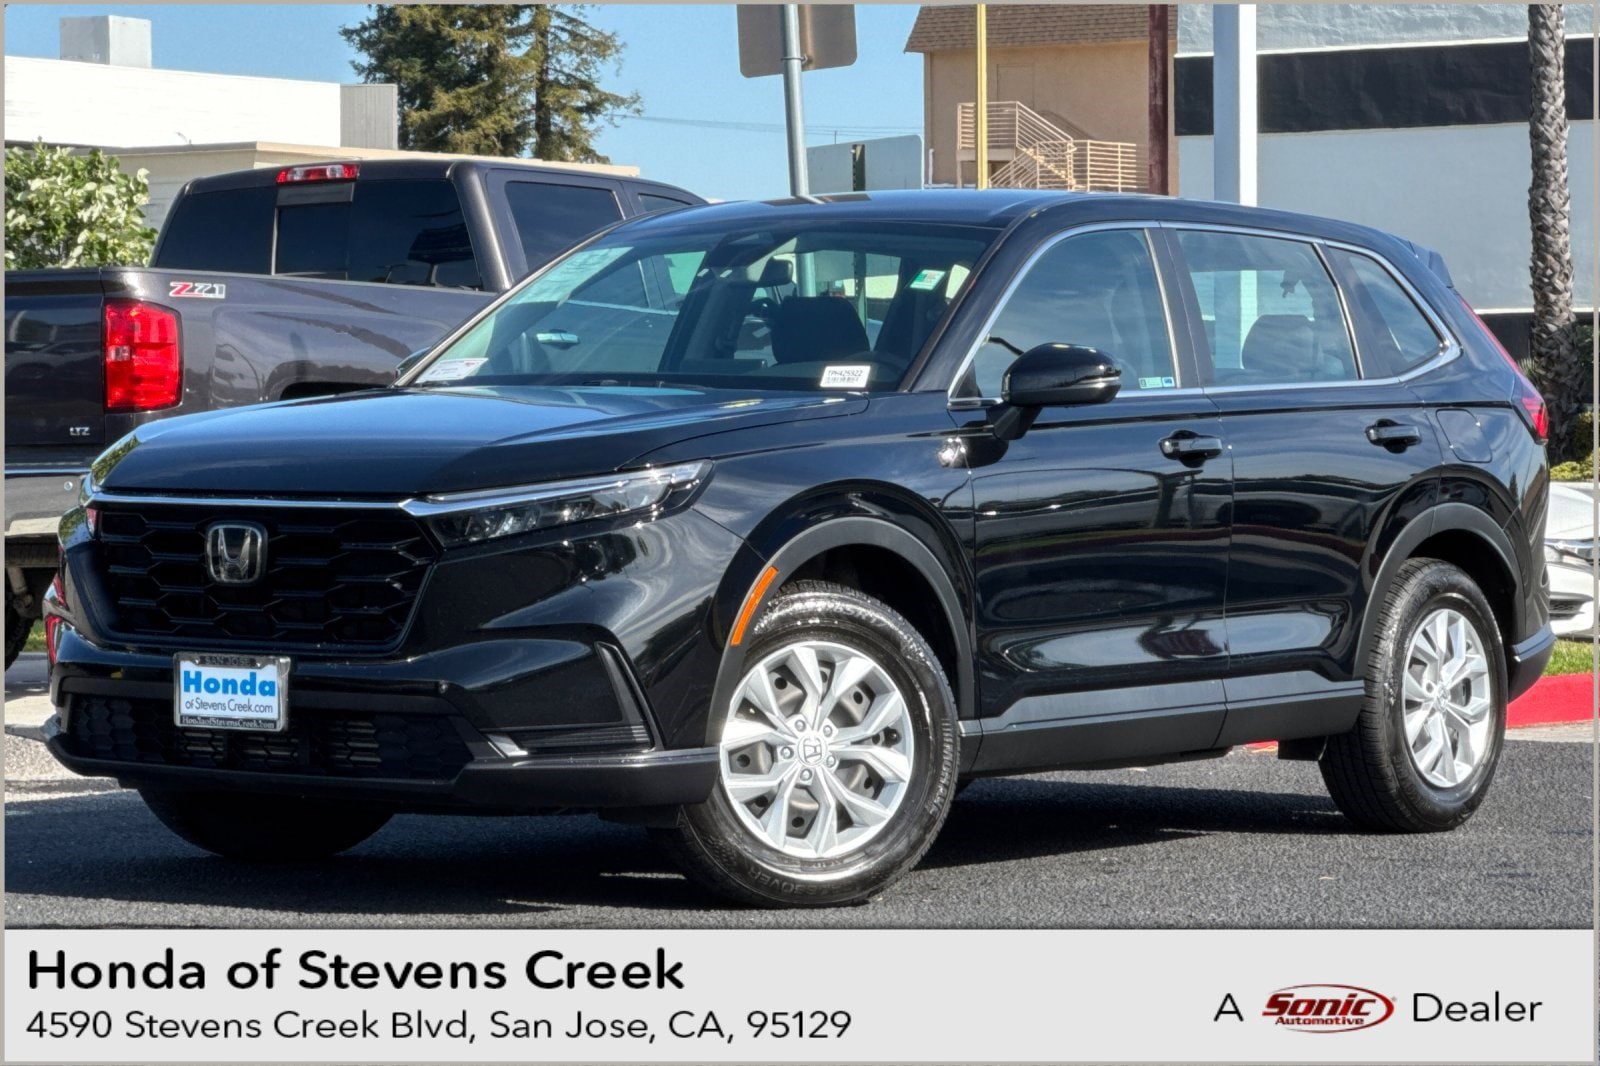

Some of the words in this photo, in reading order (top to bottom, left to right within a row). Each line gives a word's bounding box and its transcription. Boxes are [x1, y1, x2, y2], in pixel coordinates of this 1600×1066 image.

[69, 426, 90, 436] LTZ
[183, 670, 276, 697] Honda
[185, 699, 194, 709] of
[195, 697, 226, 712] Stevens
[227, 698, 274, 714] Creek.com
